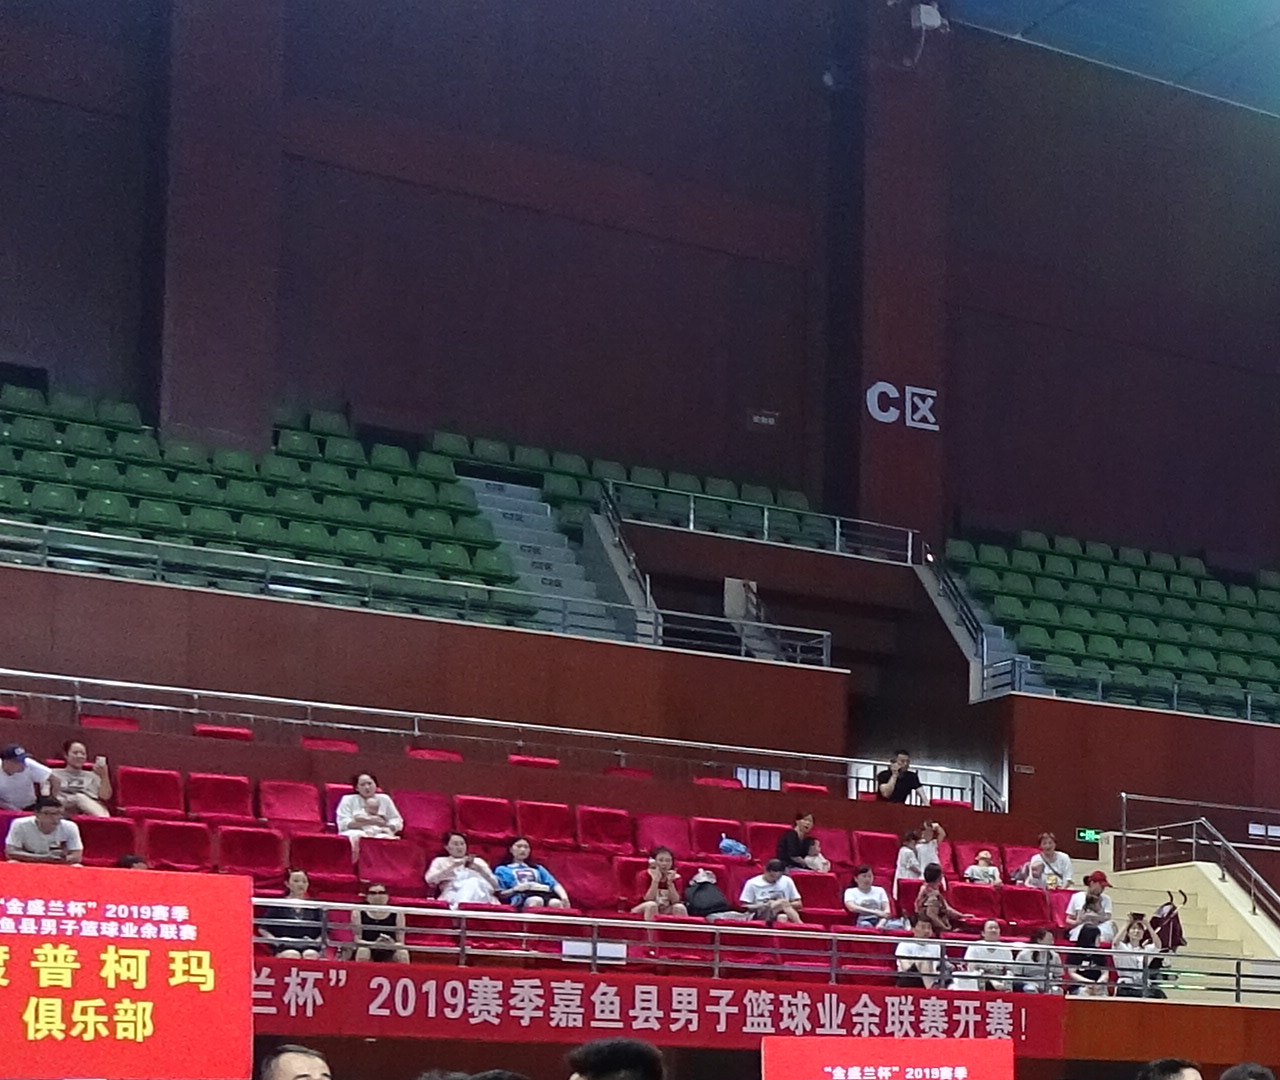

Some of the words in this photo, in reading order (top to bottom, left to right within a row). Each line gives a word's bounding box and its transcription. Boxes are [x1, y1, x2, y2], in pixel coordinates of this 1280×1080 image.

[866, 381, 940, 431] C区
[0, 943, 215, 992] 普柯玛
[22, 996, 154, 1042] 俱乐部
